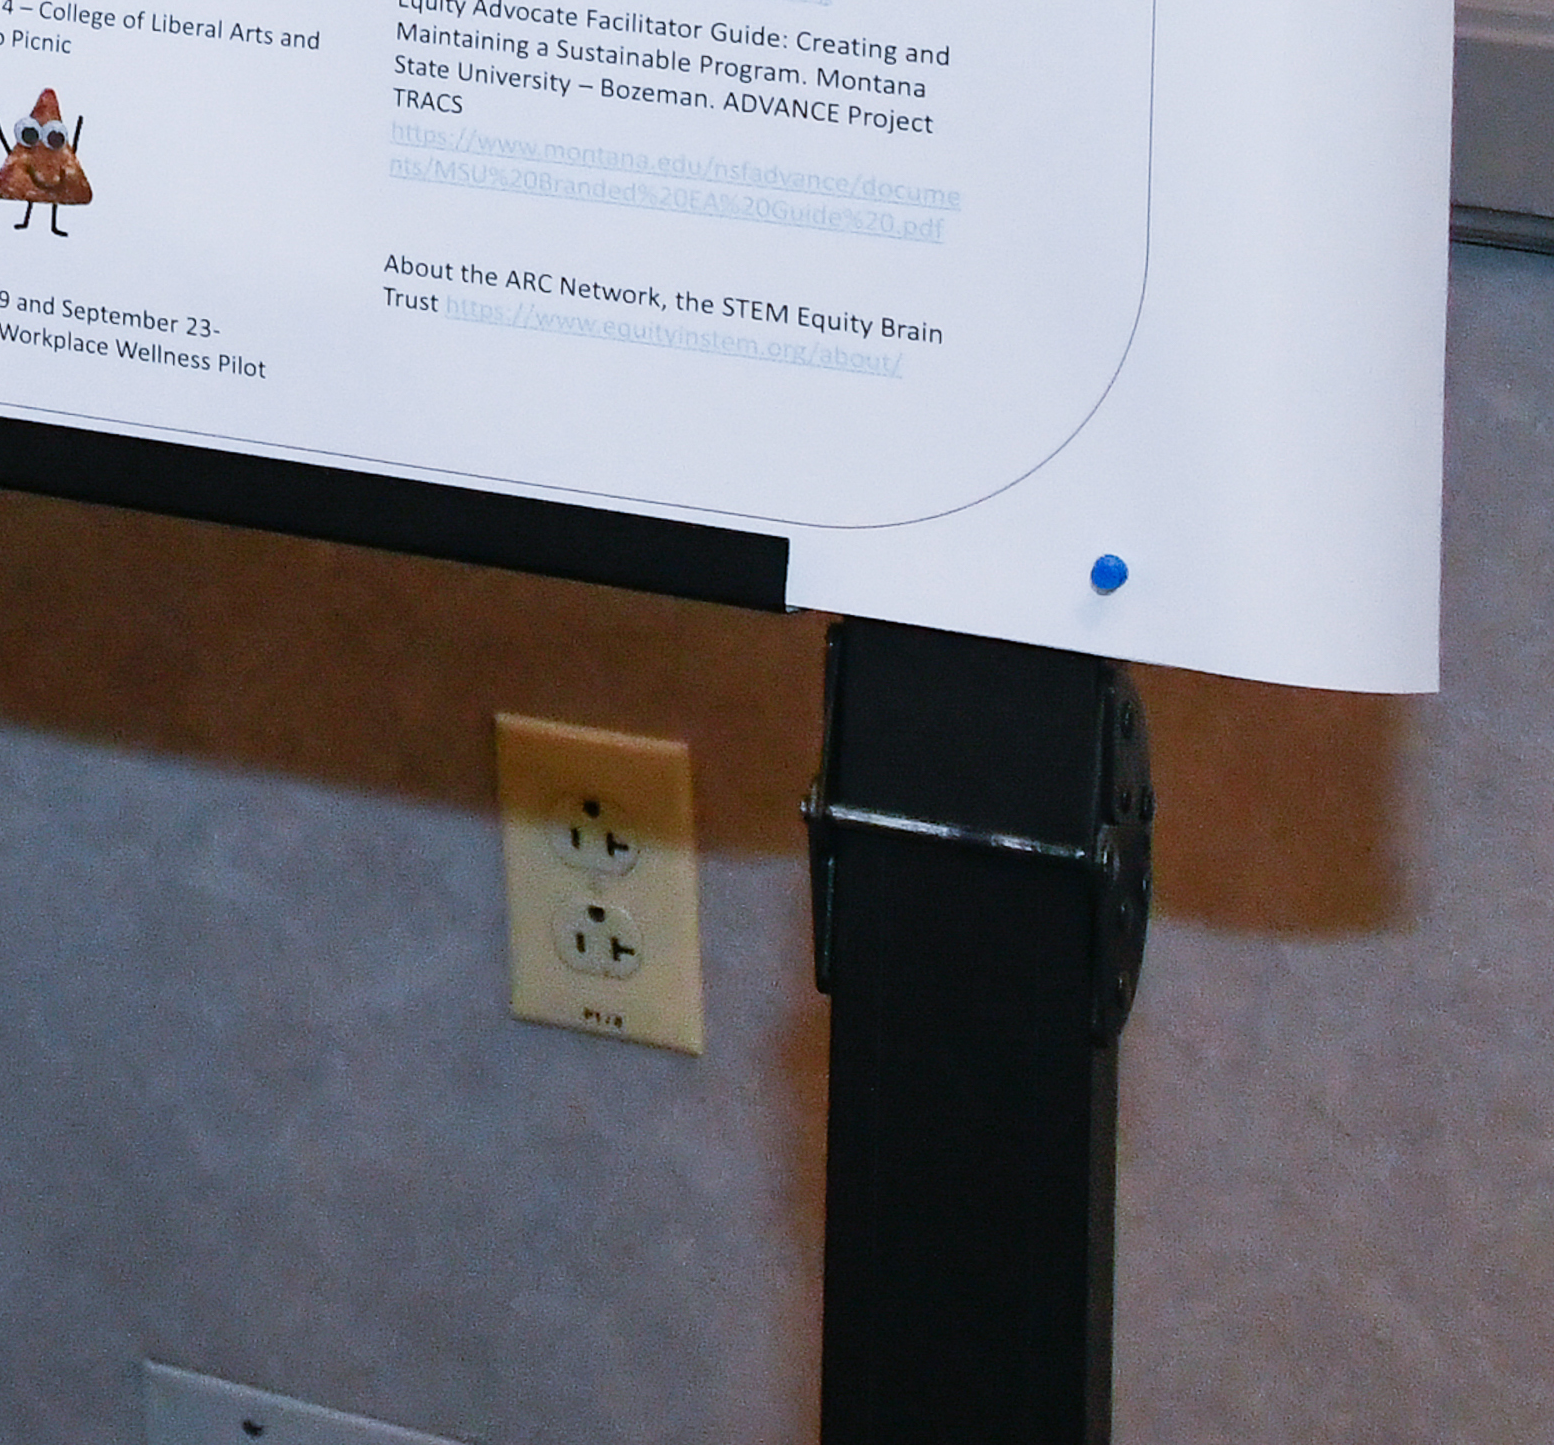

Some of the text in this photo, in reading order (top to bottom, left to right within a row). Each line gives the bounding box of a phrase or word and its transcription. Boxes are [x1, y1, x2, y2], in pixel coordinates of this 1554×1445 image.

[17, 296, 54, 315] and
[62, 299, 178, 333] September
[186, 317, 220, 338] 23-
[383, 286, 439, 312] Trust
[384, 254, 942, 344] About the ARC Network, the STEM Equity Brain
